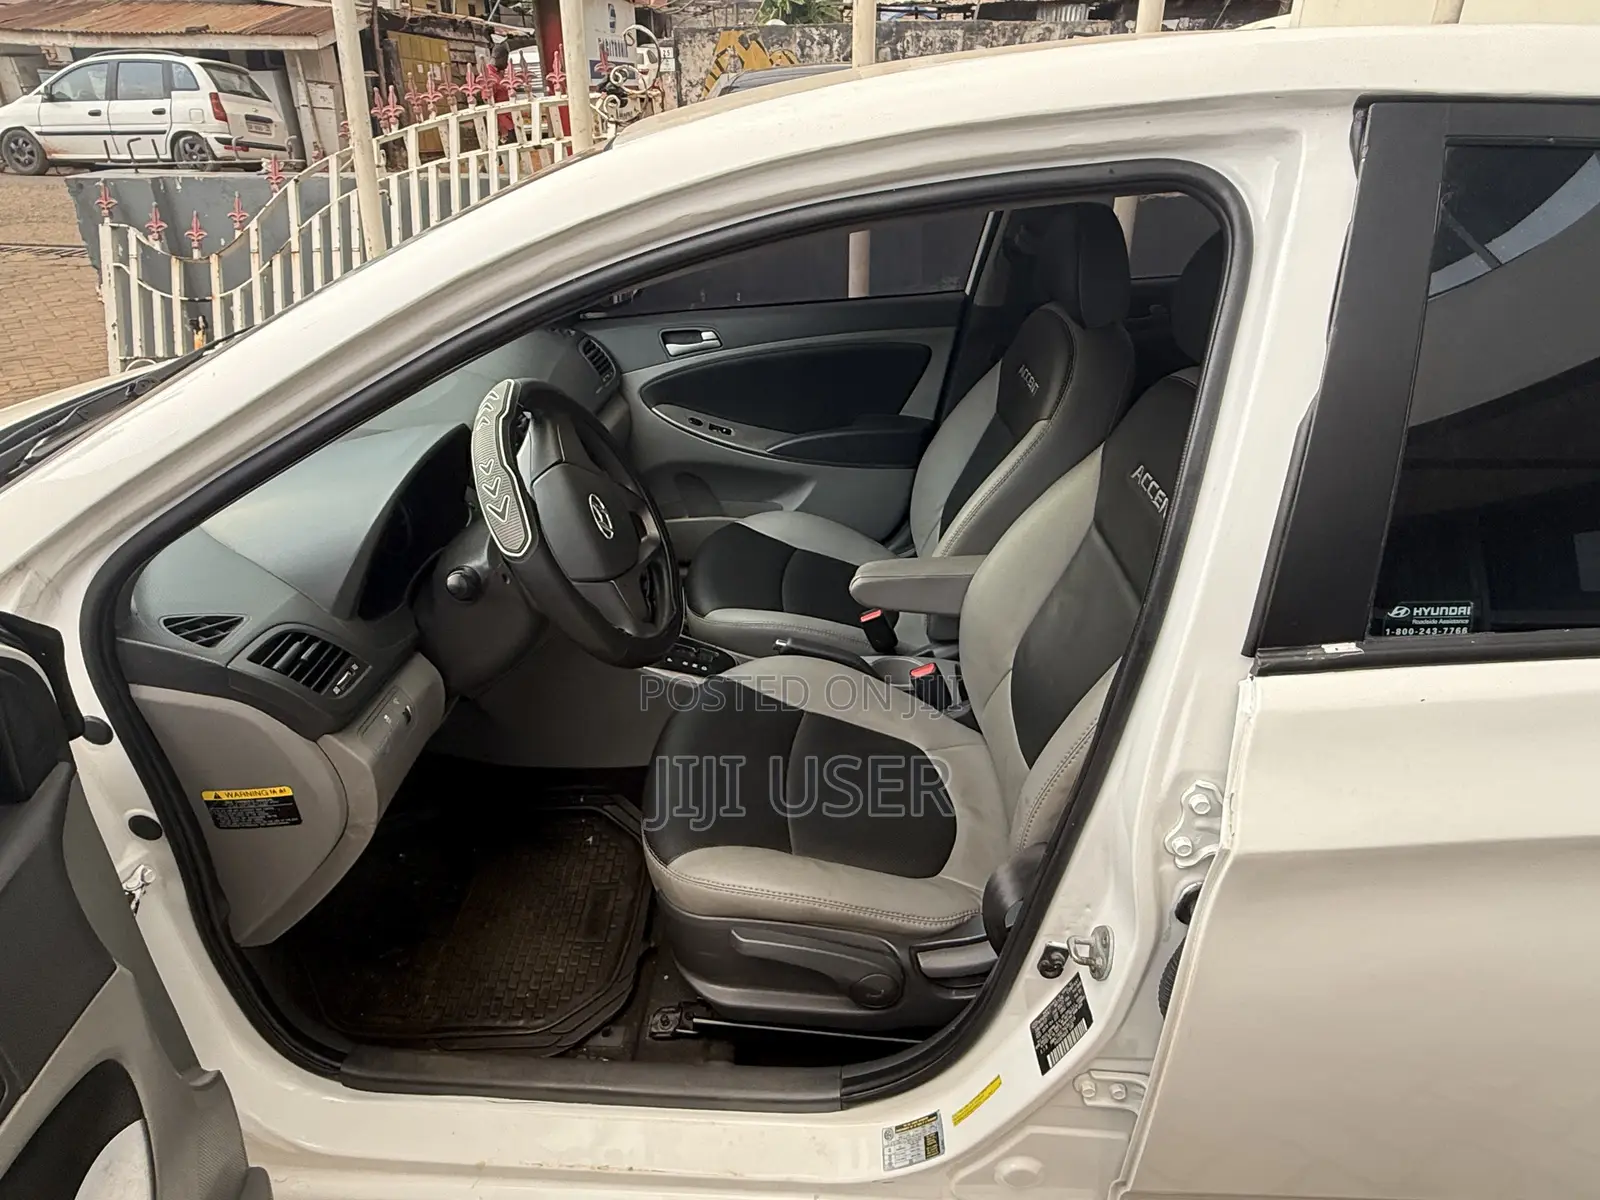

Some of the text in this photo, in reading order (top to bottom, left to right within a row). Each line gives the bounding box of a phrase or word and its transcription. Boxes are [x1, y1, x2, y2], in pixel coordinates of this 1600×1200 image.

[1017, 364, 1040, 397] ACCENT
[1130, 464, 1169, 519] ACCEN
[1412, 606, 1471, 616] HYUNDAI
[1385, 626, 1469, 636] 1-800-243-7766
[224, 789, 269, 799] WARNING
